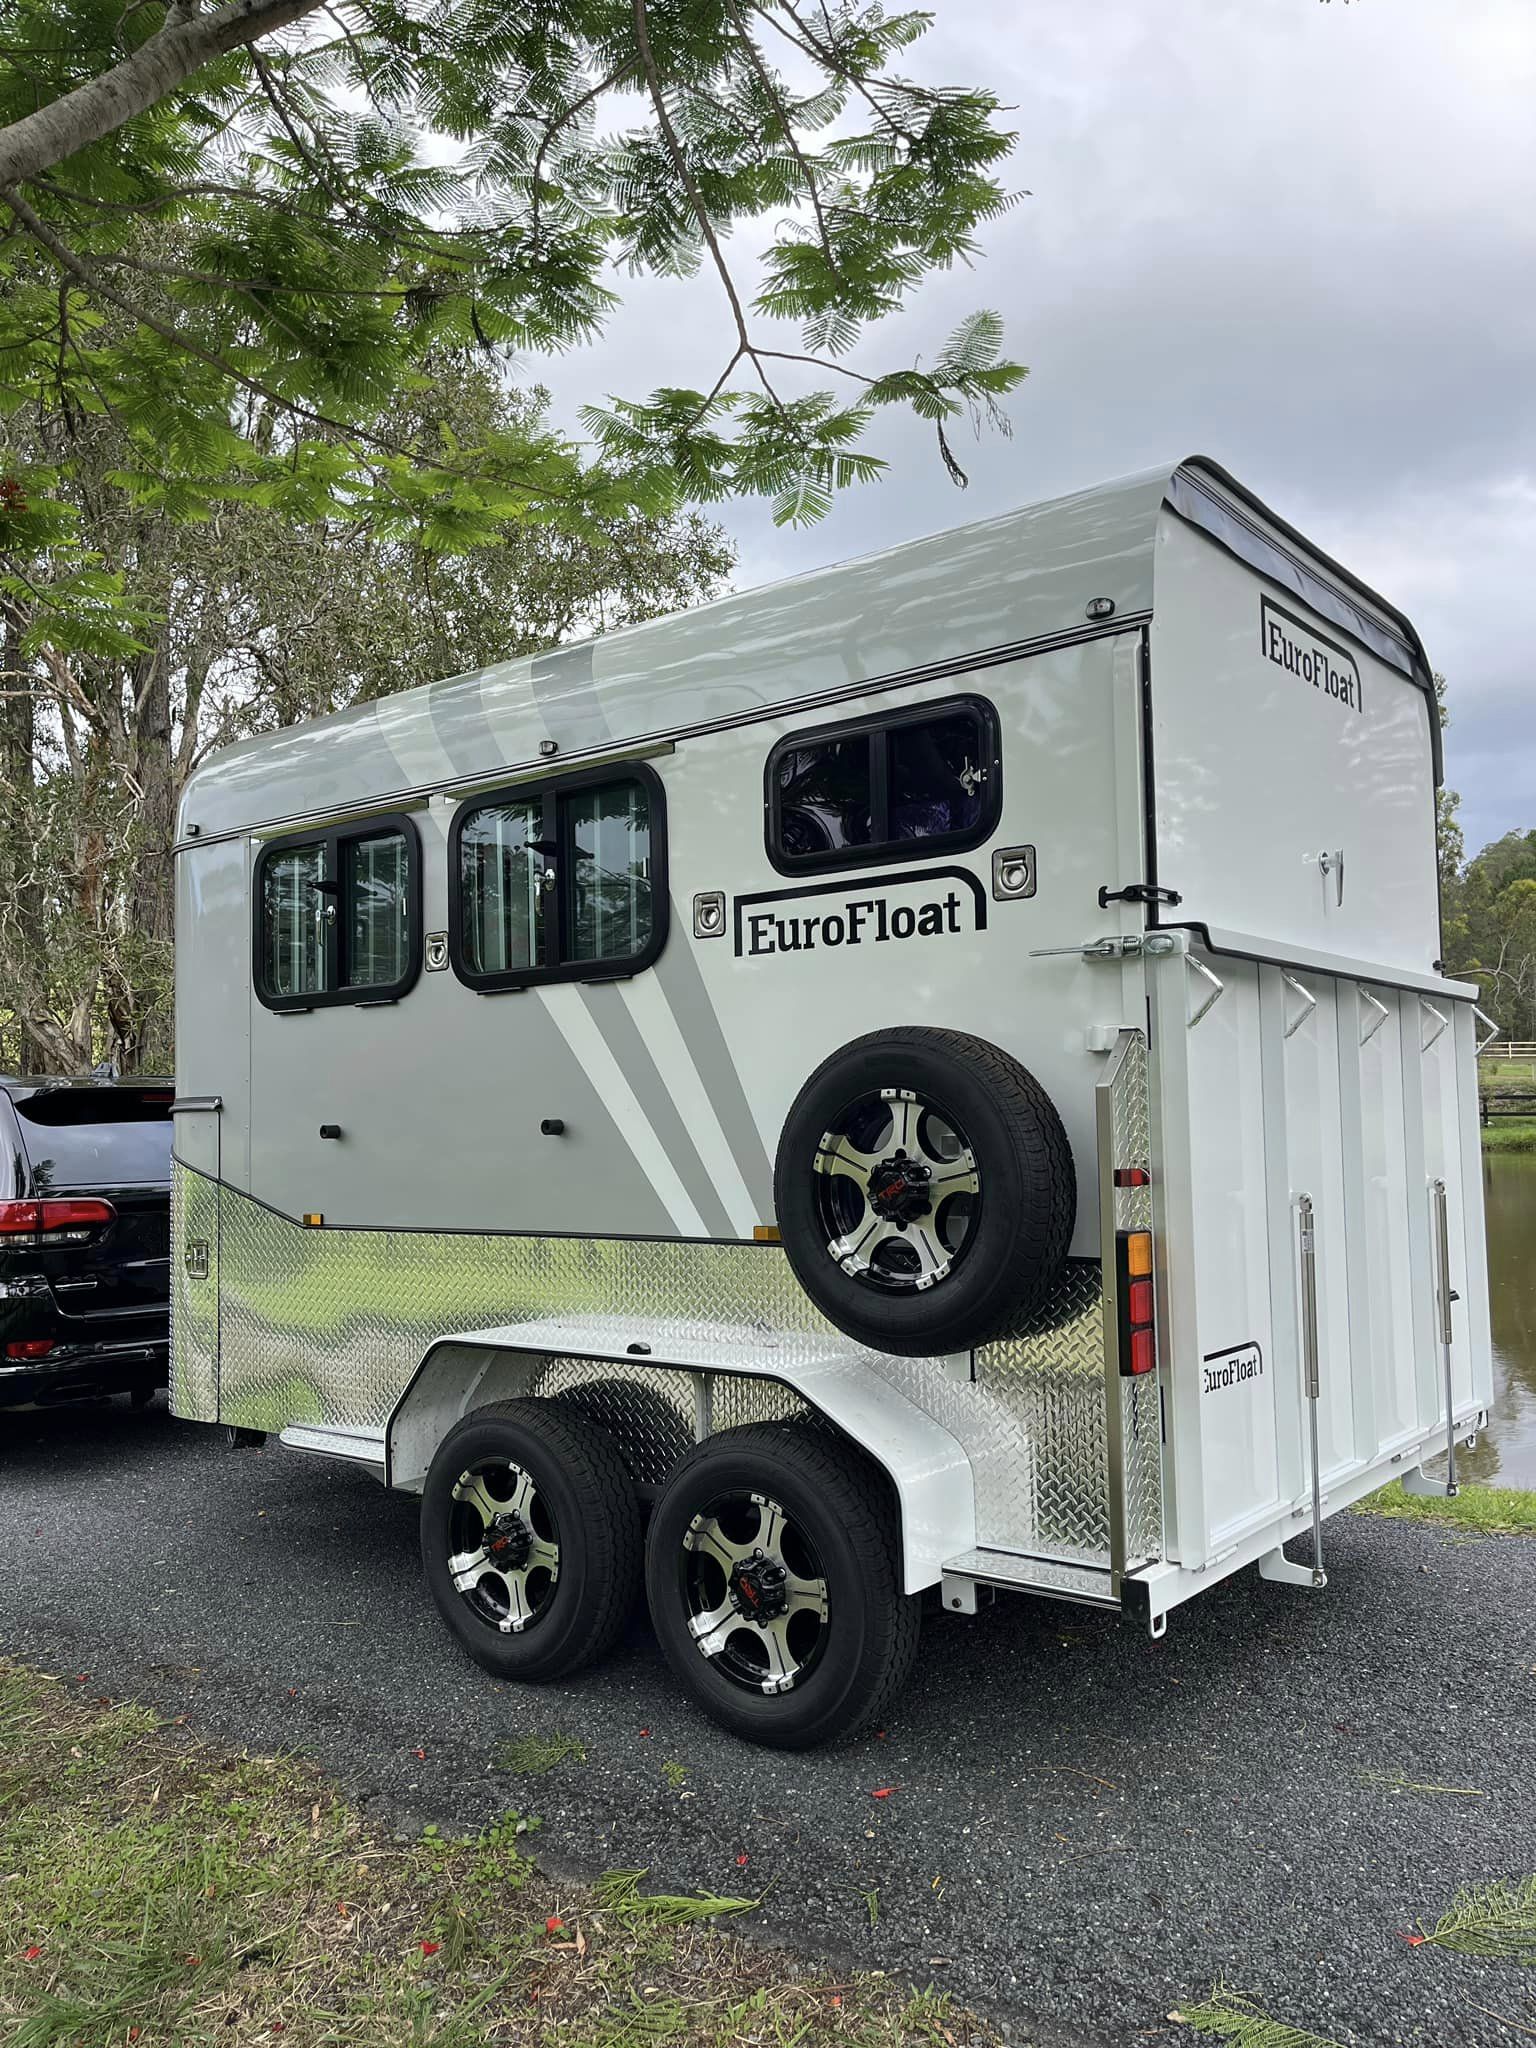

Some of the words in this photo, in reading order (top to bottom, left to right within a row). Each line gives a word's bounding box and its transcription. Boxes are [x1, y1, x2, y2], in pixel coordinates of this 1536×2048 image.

[1268, 620, 1354, 709] EuroFloat
[748, 892, 961, 956] EuroFloat
[880, 1178, 906, 1200] TRD
